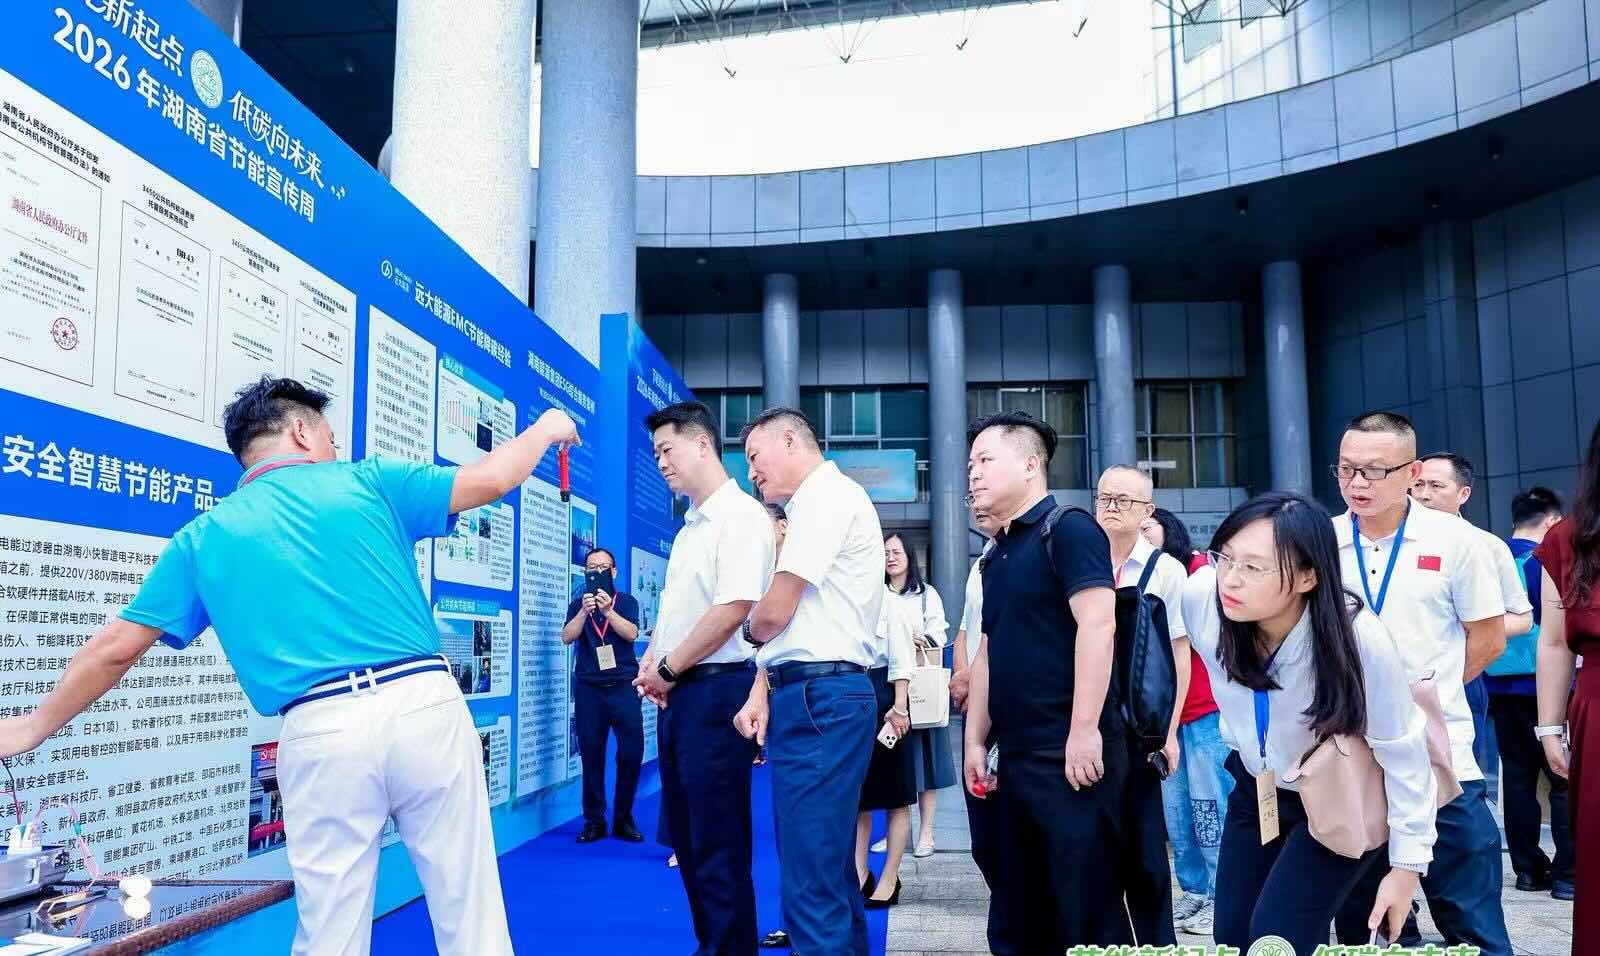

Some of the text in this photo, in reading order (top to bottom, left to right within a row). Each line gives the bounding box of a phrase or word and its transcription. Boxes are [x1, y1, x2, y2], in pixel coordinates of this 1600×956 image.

[228, 90, 324, 190] 低碳向未来
